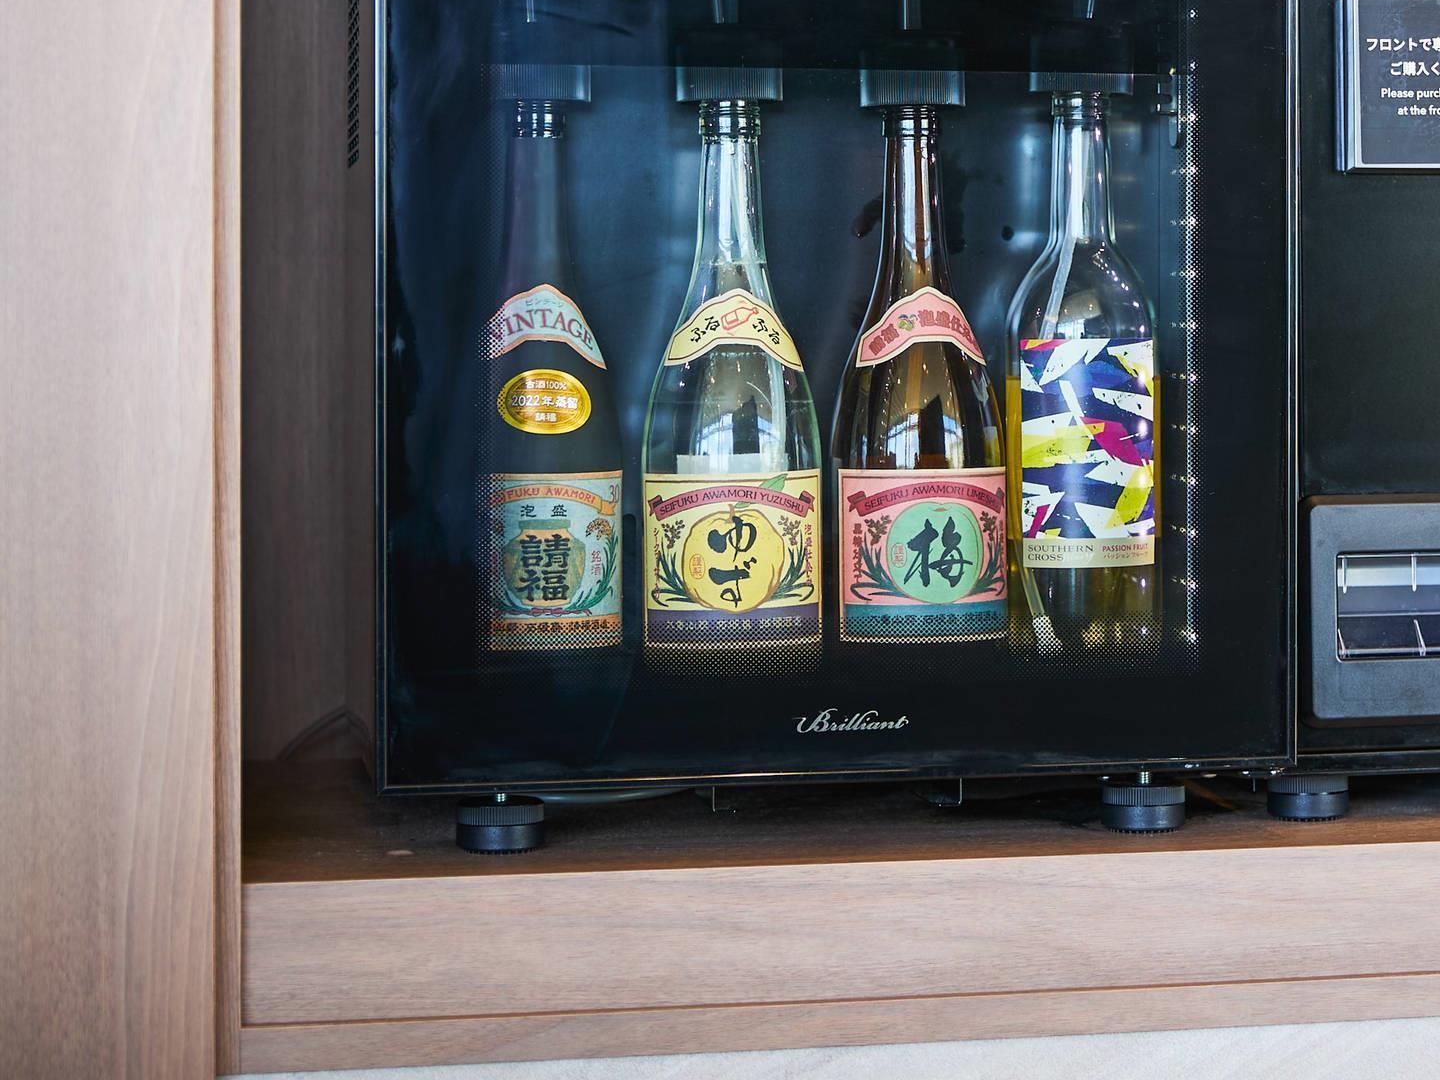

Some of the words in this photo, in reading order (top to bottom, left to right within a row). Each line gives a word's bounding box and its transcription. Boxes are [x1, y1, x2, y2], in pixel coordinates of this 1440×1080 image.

[1380, 87, 1415, 99] Please
[1397, 106, 1409, 116] at
[1410, 104, 1427, 116] the
[490, 307, 595, 351] INTAGE
[546, 488, 596, 504] AWAMORI
[659, 493, 700, 515] SEIFUKU
[702, 488, 758, 501] AWAMORI
[759, 491, 805, 514] YUZUSHU
[864, 490, 909, 511] SEIFUKU
[911, 484, 965, 497] AWAMORI
[520, 504, 568, 518] 泡盛
[903, 516, 974, 588] 梅
[1027, 544, 1094, 553] SOUTHERN
[1102, 543, 1132, 552] PASSION
[1132, 543, 1149, 551] FRUIT
[1027, 553, 1064, 561] CROSS
[793, 707, 909, 734] Brilliant
